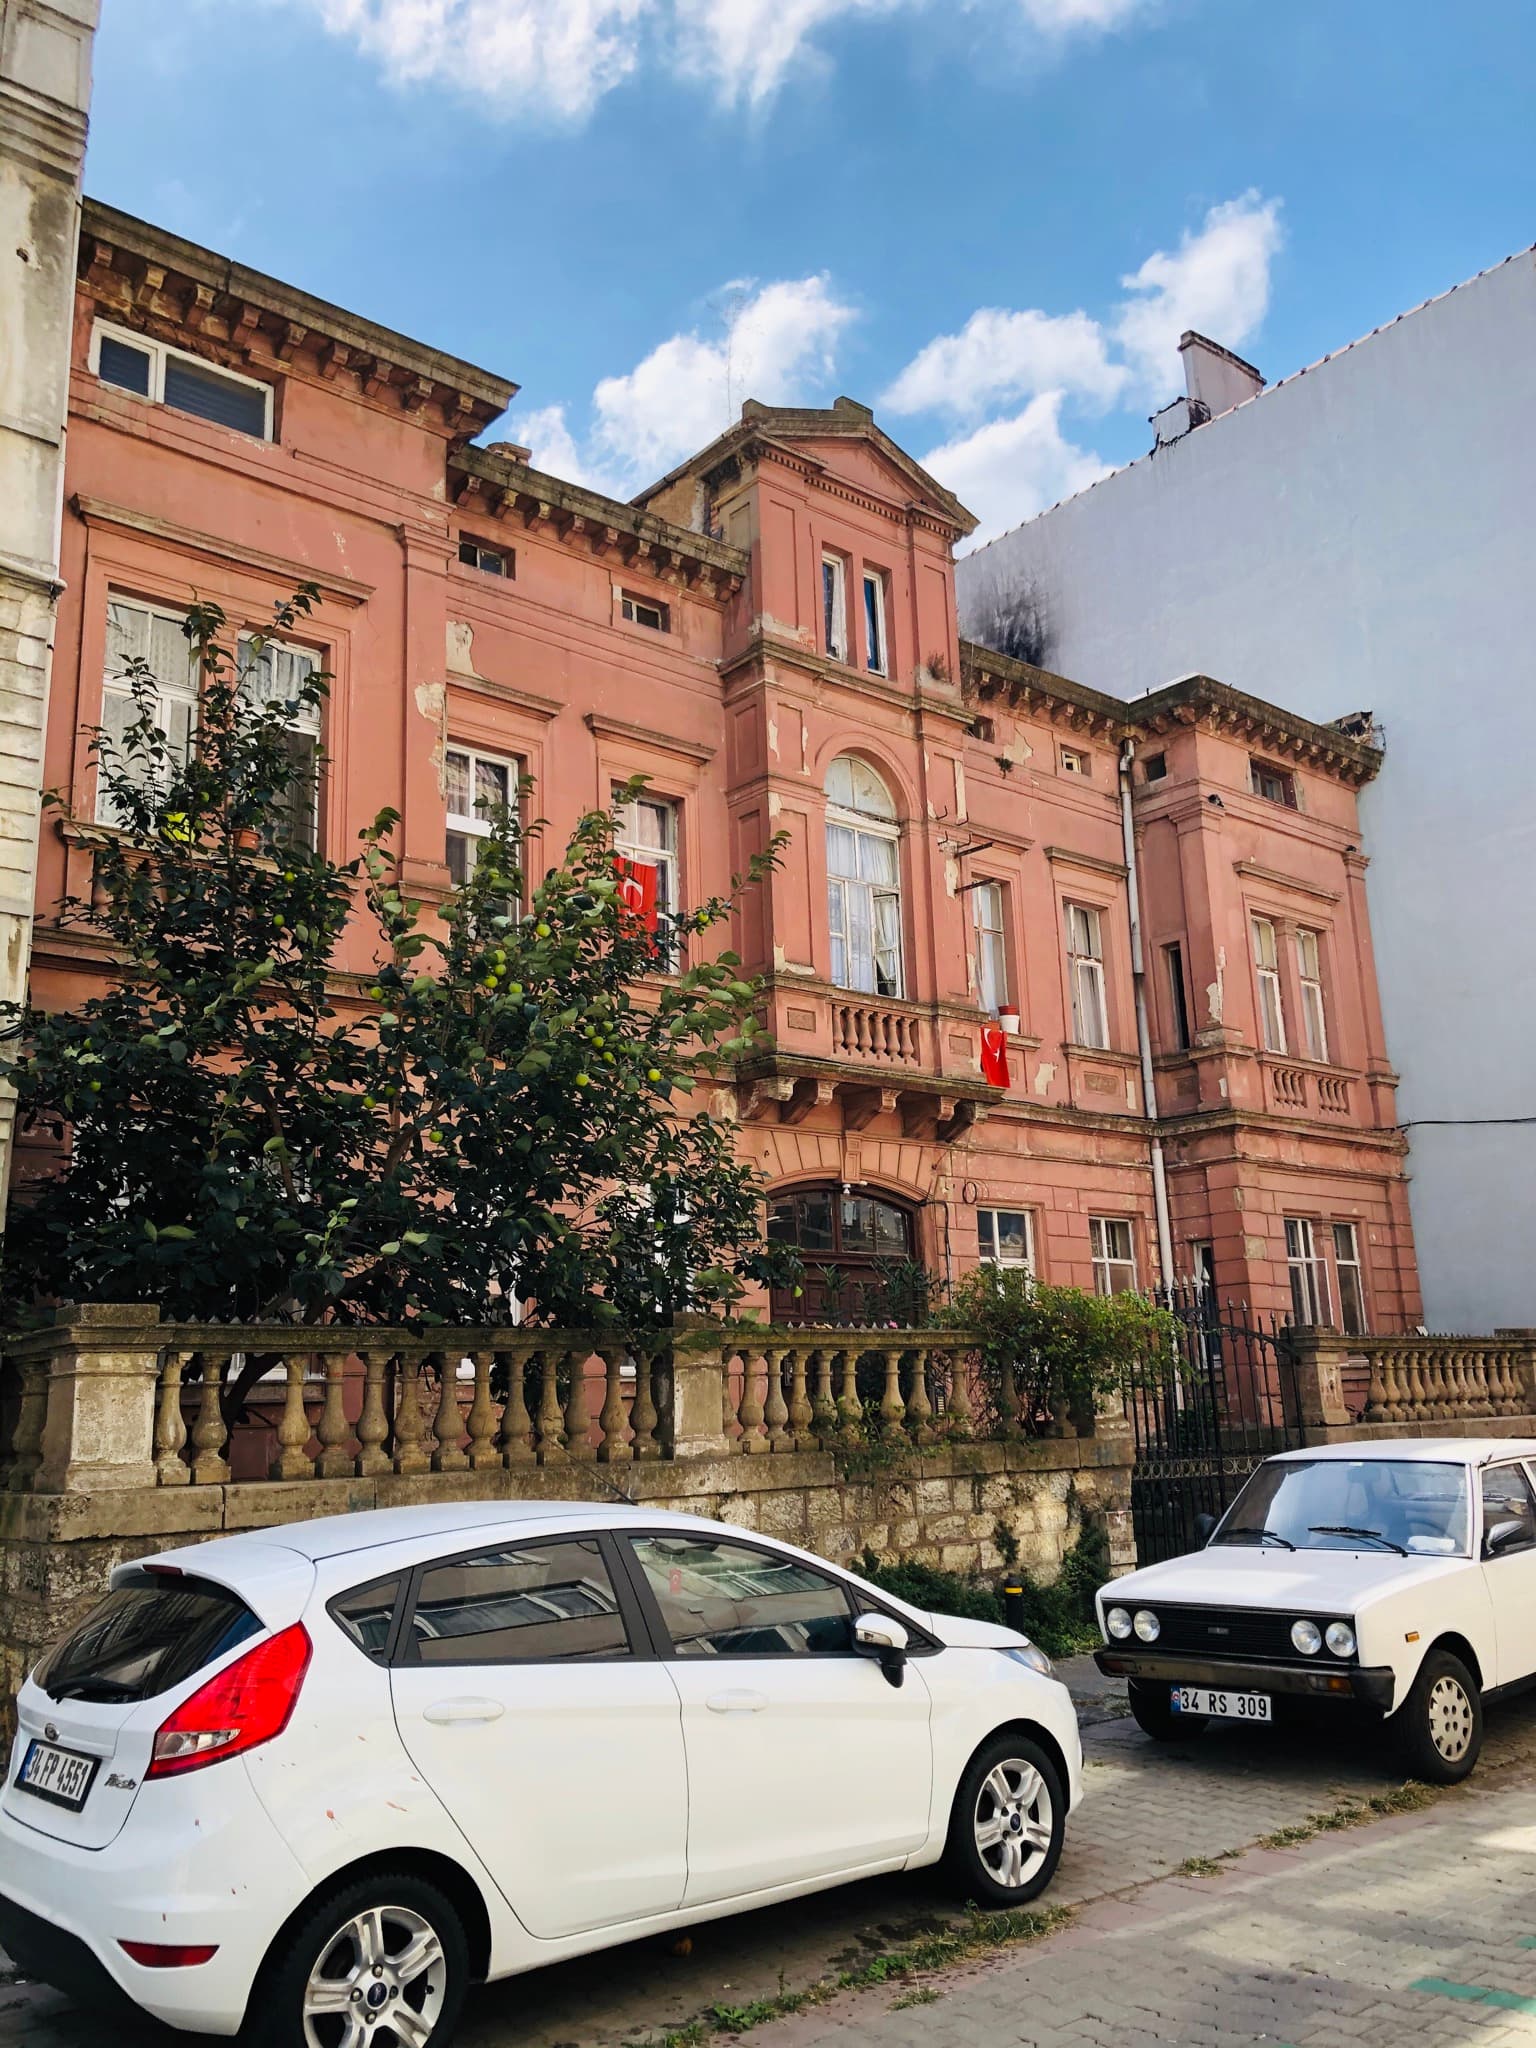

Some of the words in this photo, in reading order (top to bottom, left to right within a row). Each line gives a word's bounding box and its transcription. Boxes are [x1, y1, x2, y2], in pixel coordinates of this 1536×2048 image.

[1181, 1690, 1199, 1710] 34
[1209, 1693, 1227, 1713] RS
[1238, 1696, 1267, 1717] 309
[27, 1748, 44, 1782] 34
[40, 1753, 59, 1787] FP
[57, 1757, 89, 1797] 4551
